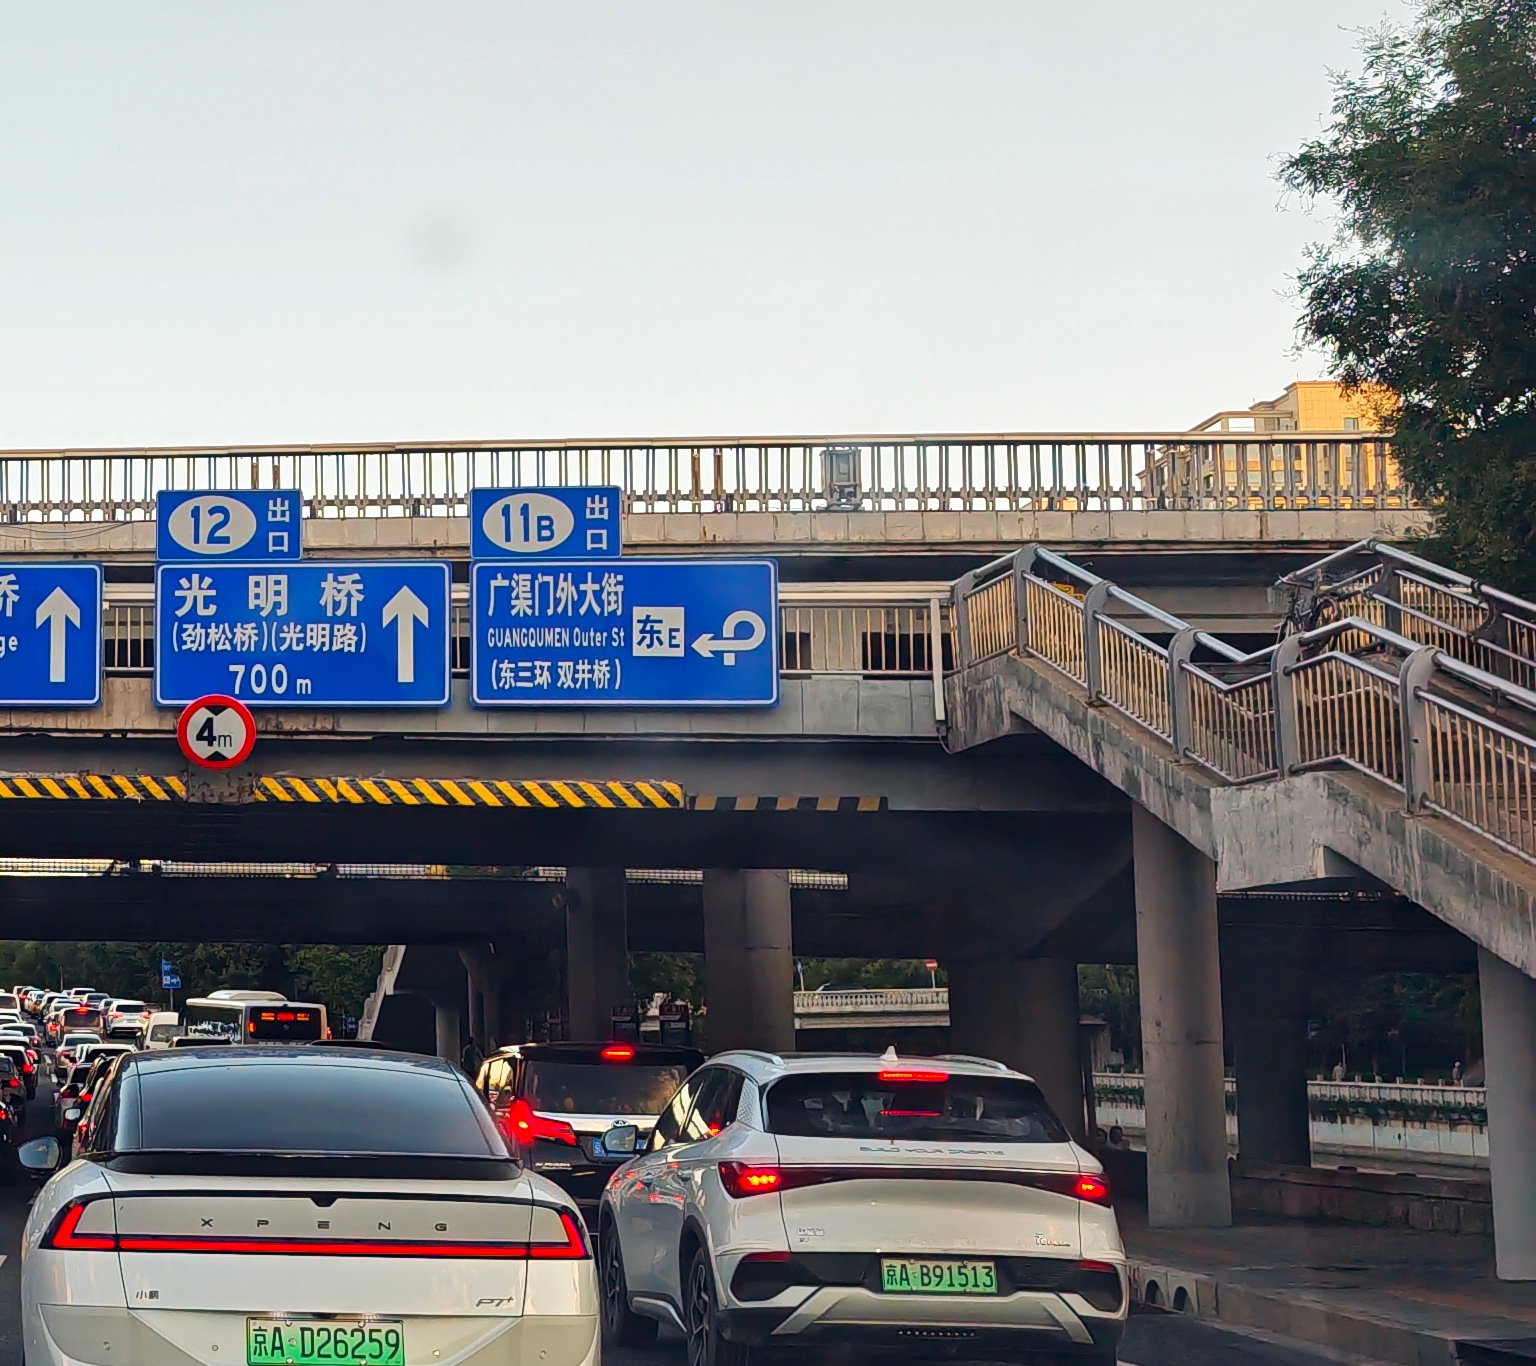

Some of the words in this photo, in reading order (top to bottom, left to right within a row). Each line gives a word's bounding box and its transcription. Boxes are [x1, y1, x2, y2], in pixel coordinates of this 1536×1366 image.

[190, 505, 231, 545] 12
[267, 497, 290, 553] 出口
[501, 502, 555, 543] 11B
[585, 494, 609, 551] 出口
[174, 572, 365, 618] 光明桥
[487, 571, 624, 618] 广渠门外大街
[487, 627, 570, 648] GUANGQUMEN
[573, 626, 608, 647] Outer
[611, 626, 625, 647] St
[228, 663, 288, 695] 700
[200, 1217, 448, 1232] XPENG
